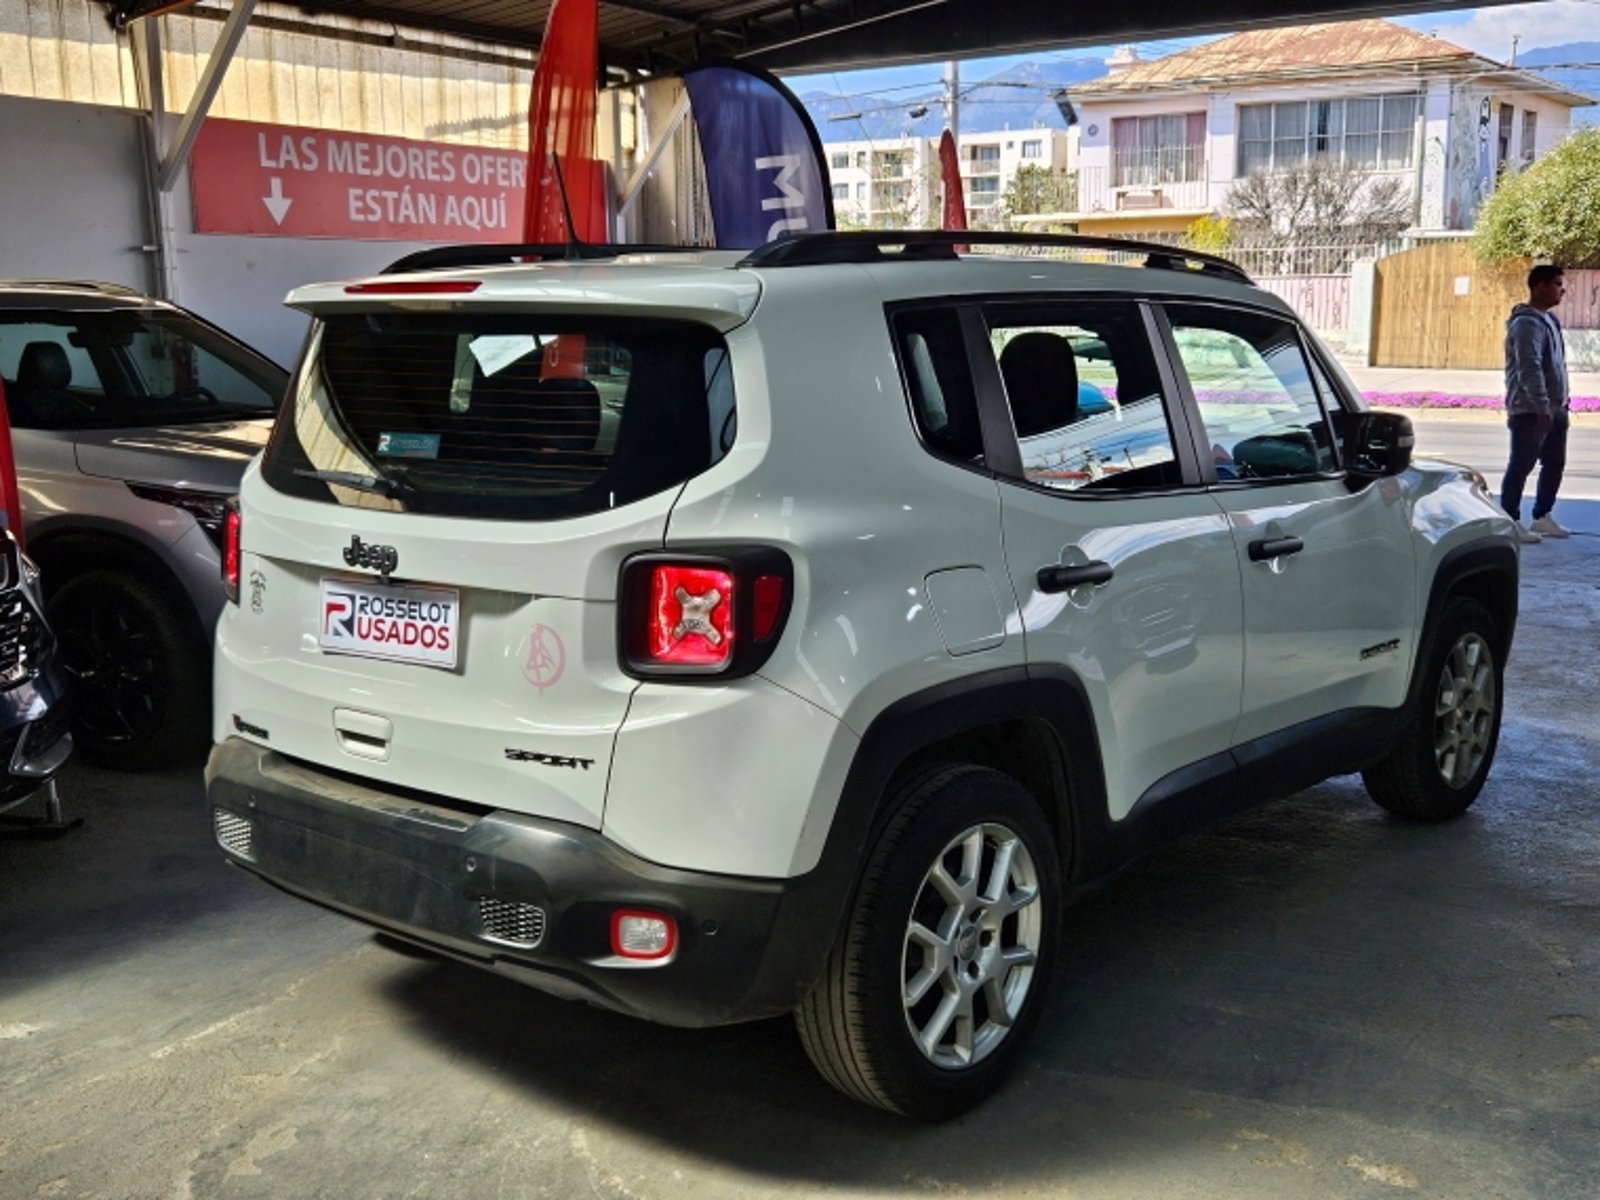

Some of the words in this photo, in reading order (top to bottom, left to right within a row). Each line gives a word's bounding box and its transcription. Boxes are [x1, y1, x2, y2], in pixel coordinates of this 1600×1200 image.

[258, 132, 319, 171] LAS
[327, 139, 456, 182] MEJORES
[462, 153, 528, 188] OFER
[348, 185, 437, 224] ESTÁN
[444, 192, 507, 232] AQUÍ
[358, 596, 451, 624] ROSSELOT
[357, 617, 450, 650] USADOS
[505, 748, 595, 770] SPORT
